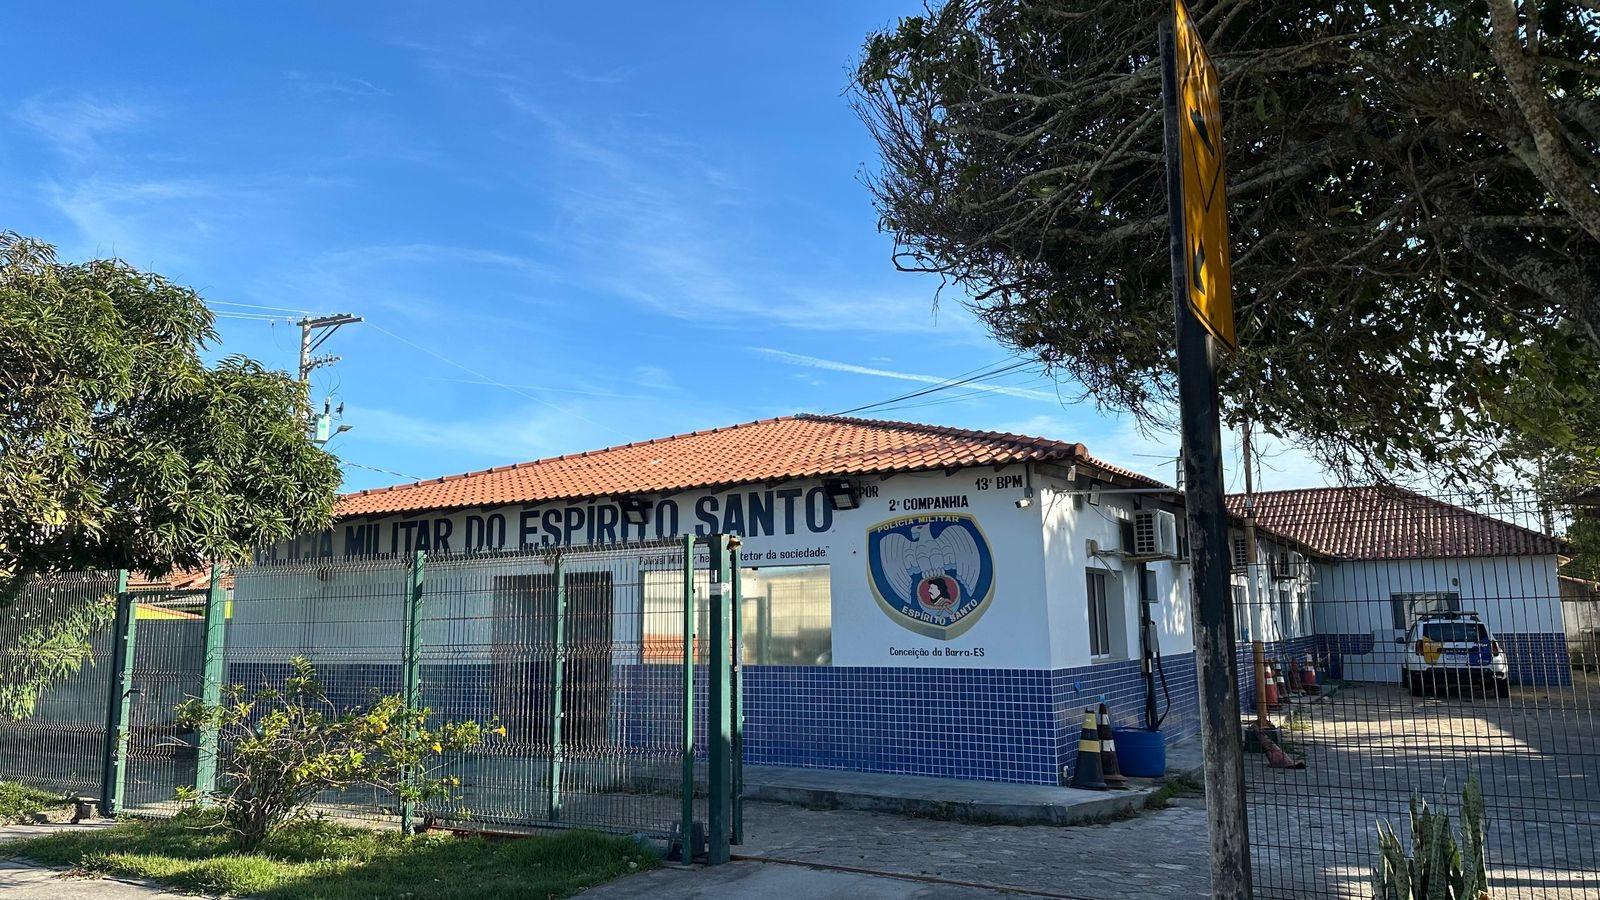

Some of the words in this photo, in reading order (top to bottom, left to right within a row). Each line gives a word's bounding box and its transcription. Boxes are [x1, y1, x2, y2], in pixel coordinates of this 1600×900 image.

[996, 475, 1023, 489] BPM
[903, 494, 969, 511] COMPANHIA
[345, 518, 453, 561] MILITAR
[465, 513, 506, 556] DO
[695, 486, 833, 538] SANTO
[918, 515, 960, 523] MILITAR
[740, 551, 763, 561] tetor
[766, 549, 777, 559] da
[949, 598, 978, 622] SANTO
[889, 646, 930, 659] Conceição
[932, 647, 942, 656] da
